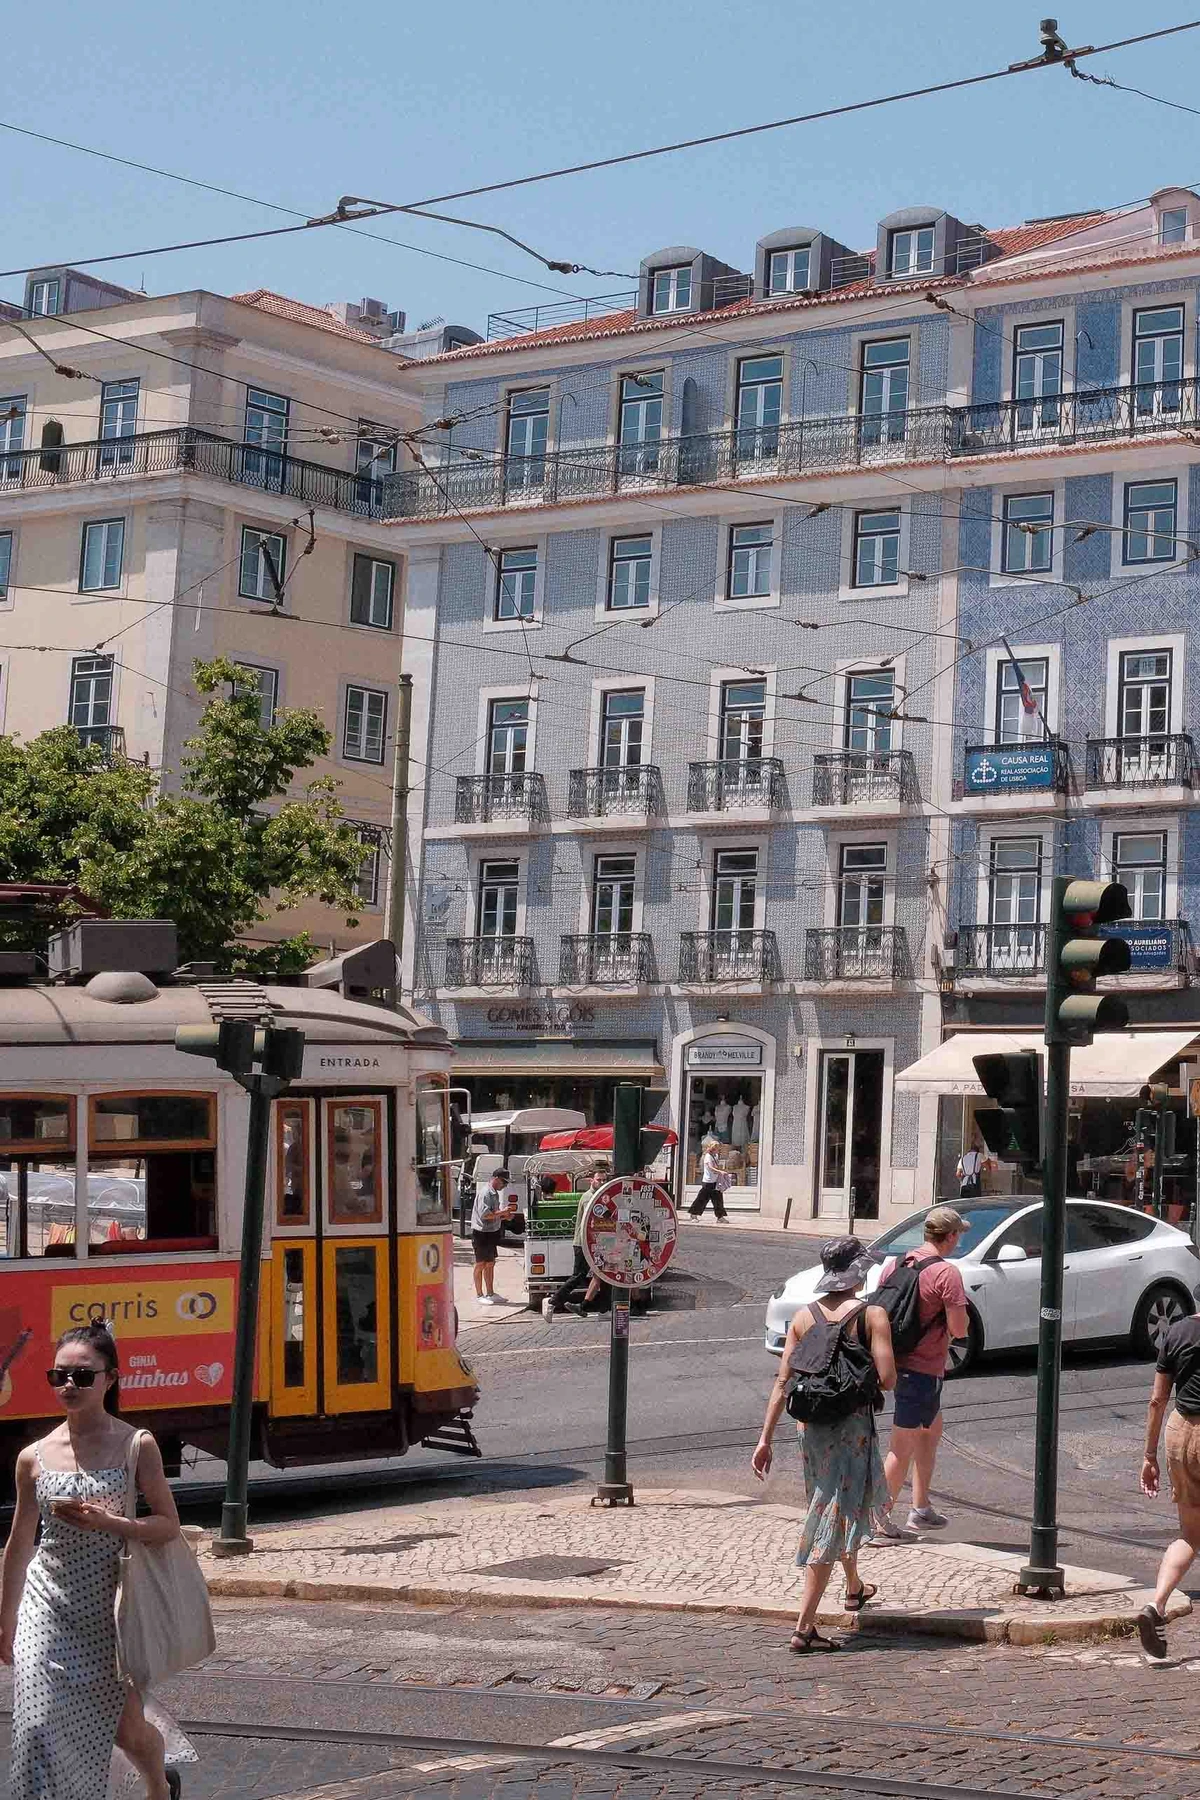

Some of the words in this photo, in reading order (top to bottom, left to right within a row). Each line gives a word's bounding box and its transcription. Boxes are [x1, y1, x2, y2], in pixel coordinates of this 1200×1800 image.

[1001, 756, 1028, 765] CAUSA
[1029, 755, 1049, 763] REAL
[1013, 765, 1049, 774] ASSOCIAÇÃO
[487, 1007, 541, 1022] GOMES
[544, 1010, 553, 1021] &
[693, 1051, 716, 1059] BRANDY
[727, 1051, 755, 1059] MELVILLE
[320, 1058, 380, 1067] ENTRADA
[69, 1292, 158, 1322] carris
[128, 1354, 158, 1368] GINJA
[118, 1368, 189, 1390] uinhas
